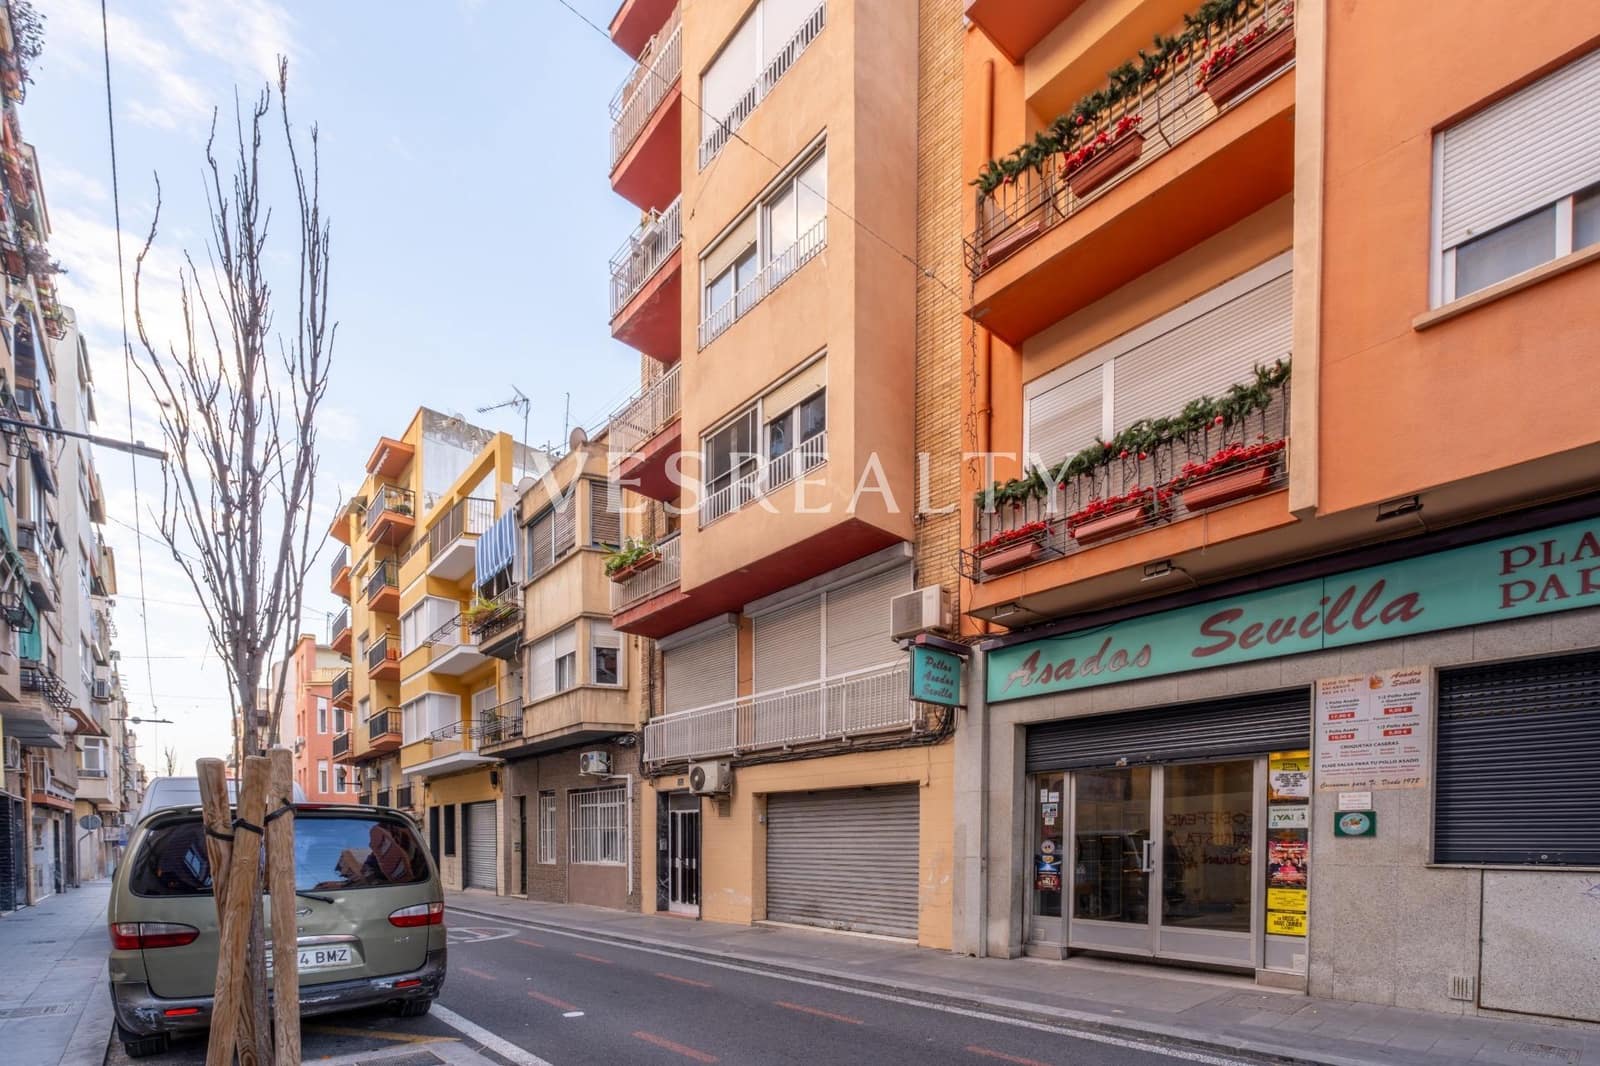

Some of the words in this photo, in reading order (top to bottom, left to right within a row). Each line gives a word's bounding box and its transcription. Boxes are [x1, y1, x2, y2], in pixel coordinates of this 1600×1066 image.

[1002, 636, 1152, 693] Asados
[1192, 578, 1426, 658] Sevilla
[315, 949, 348, 964] BMZ
